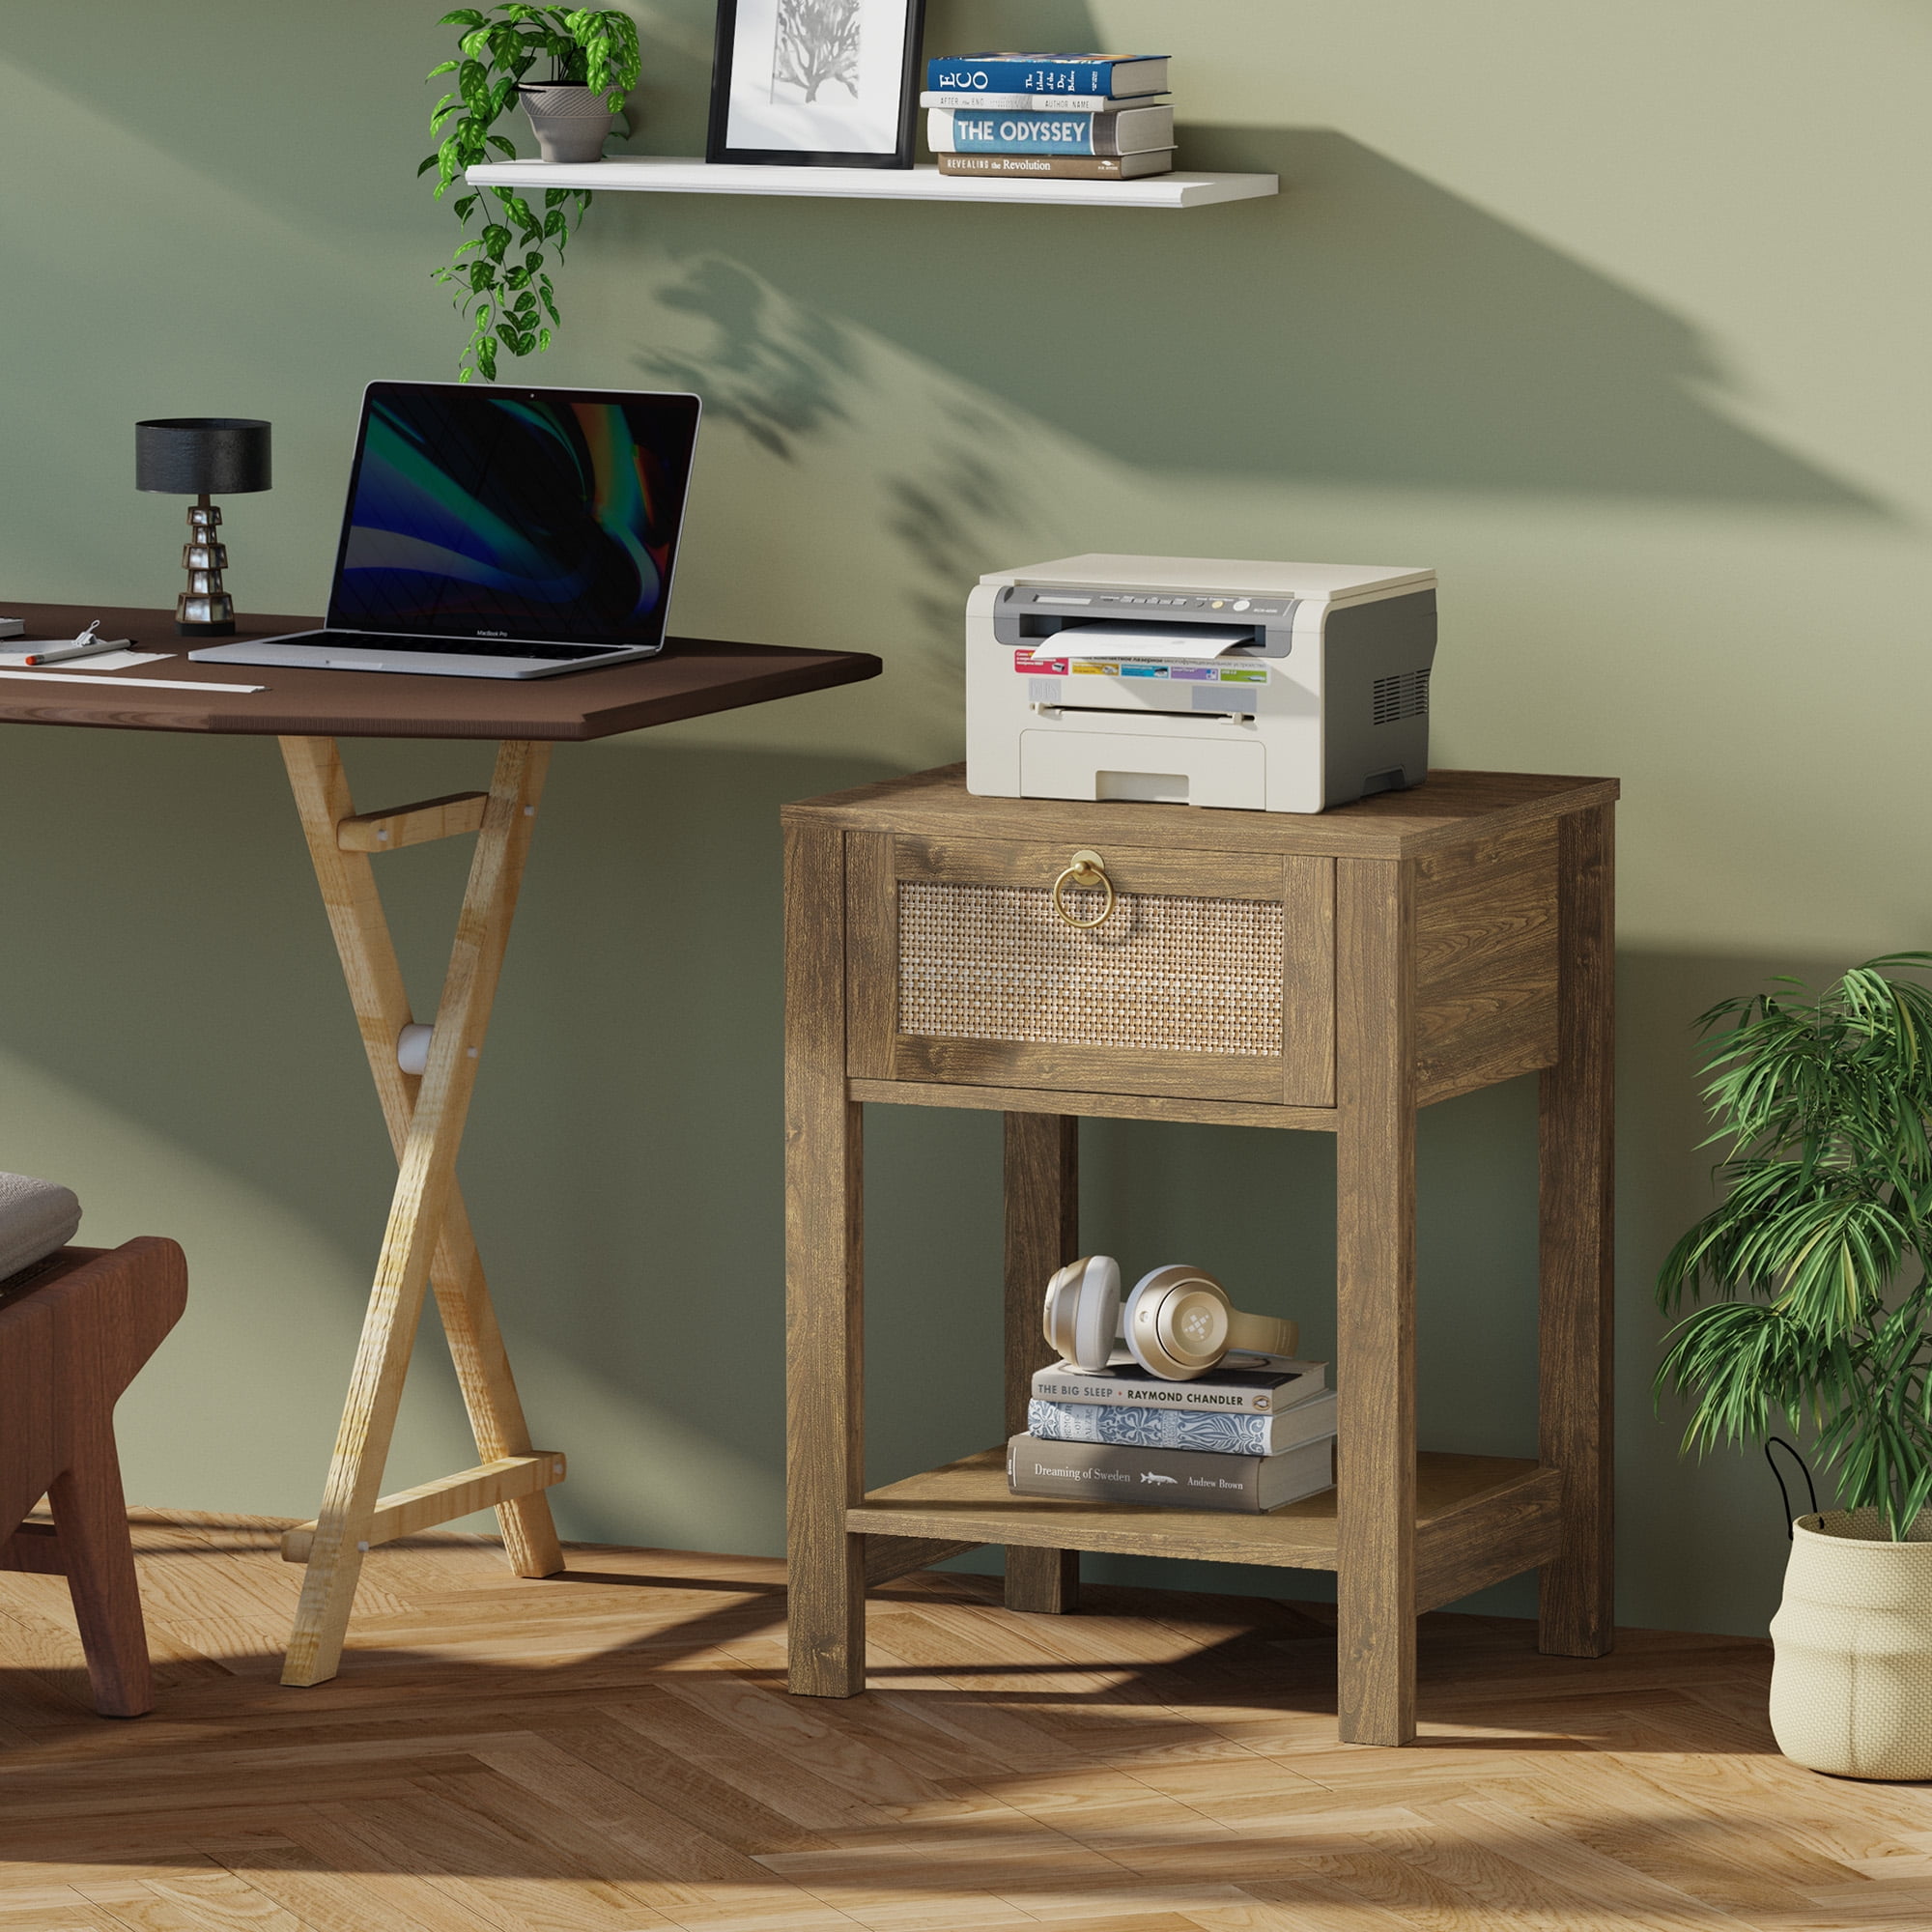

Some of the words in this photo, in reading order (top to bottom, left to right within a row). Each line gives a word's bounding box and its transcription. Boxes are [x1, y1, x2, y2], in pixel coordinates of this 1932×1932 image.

[939, 71, 988, 90] ECO
[1057, 73, 1066, 89] Day
[957, 121, 994, 140] THE
[999, 121, 1086, 142] ODYSSEY
[947, 158, 989, 170] REVEALING
[991, 161, 1001, 170] the
[1003, 158, 1051, 171] Revolution
[1037, 1384, 1058, 1395] THE
[1061, 1385, 1080, 1396] BIG
[1084, 1386, 1113, 1398] SLEEP
[1127, 1389, 1182, 1402] RAYMOND
[1186, 1393, 1243, 1406] CHANDLER
[1035, 1463, 1081, 1481] Dreaming
[1082, 1467, 1093, 1479] of
[1094, 1470, 1131, 1483] Sweden
[1186, 1476, 1216, 1488] Andrew
[1218, 1478, 1243, 1491] Brown
